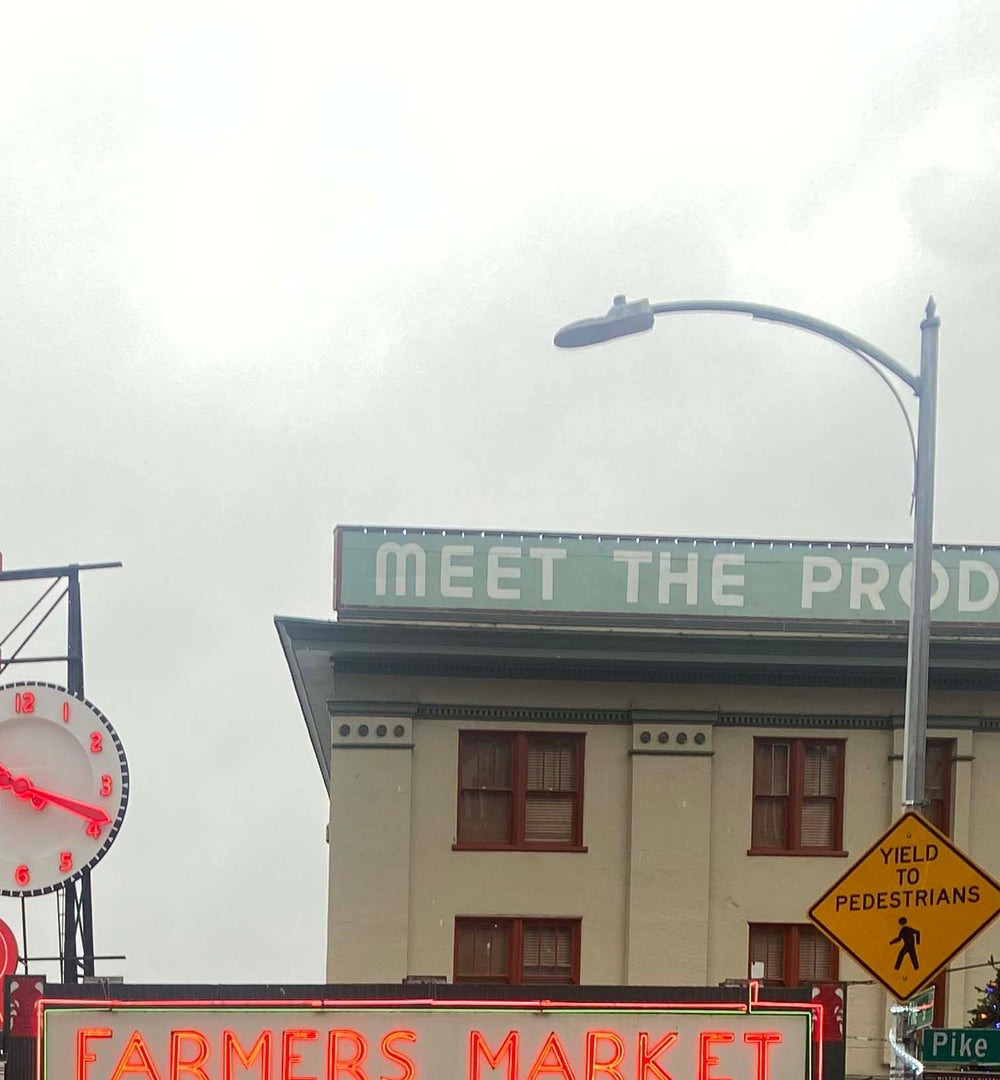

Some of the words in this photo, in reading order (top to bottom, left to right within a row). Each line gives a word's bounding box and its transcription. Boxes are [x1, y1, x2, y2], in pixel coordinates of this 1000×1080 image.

[374, 541, 568, 602] MEET
[612, 549, 747, 607] THE
[800, 554, 1000, 613] PROD
[14, 691, 36, 714] 12
[62, 701, 70, 723] 1
[90, 731, 103, 754] 2
[100, 774, 114, 797] 3
[85, 820, 101, 839] 4
[59, 851, 73, 872] 5
[880, 844, 939, 865] YIELD
[14, 864, 30, 886] 6
[896, 868, 920, 885] TO
[835, 885, 981, 912] PEDESTRIANS
[932, 1031, 988, 1058] Pike
